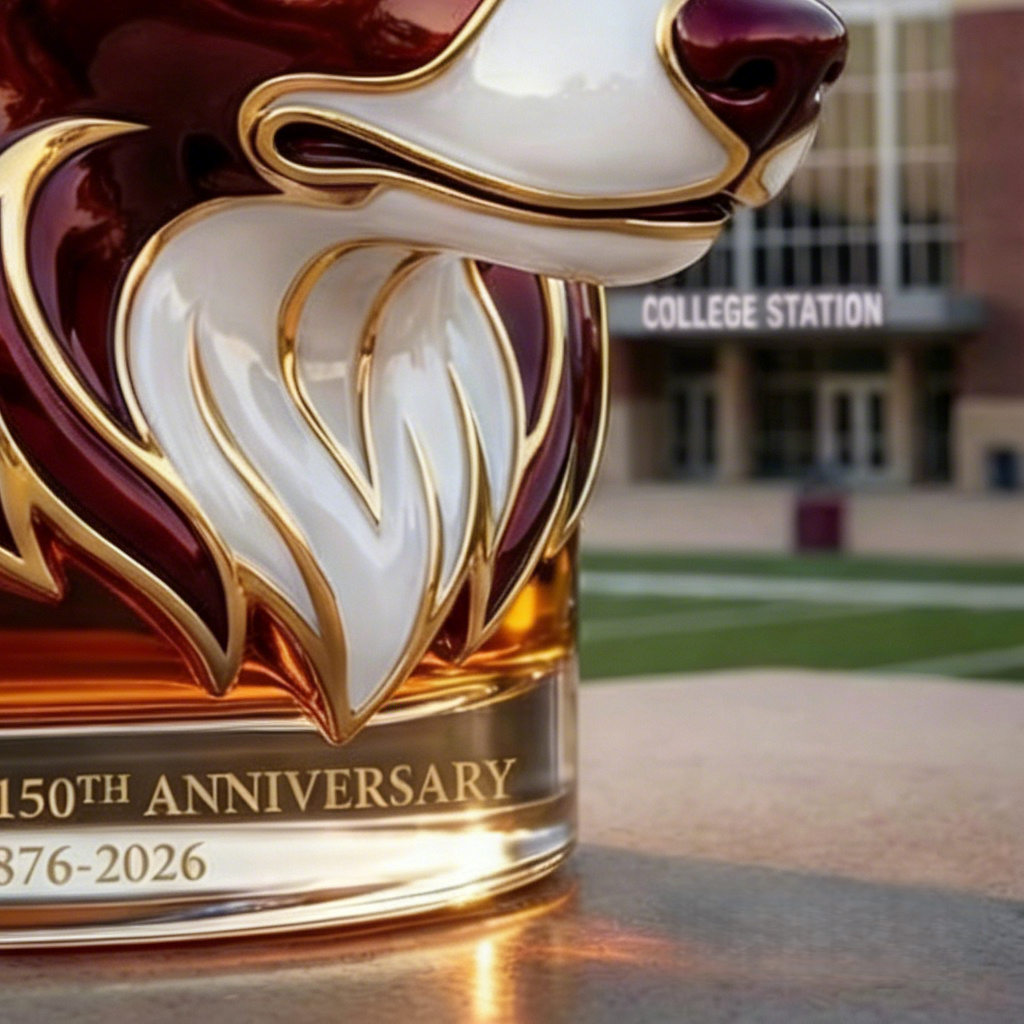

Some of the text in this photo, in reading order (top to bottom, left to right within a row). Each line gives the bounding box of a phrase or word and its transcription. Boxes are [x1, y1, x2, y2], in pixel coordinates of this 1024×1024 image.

[642, 292, 884, 329] COLLEGE STATION
[143, 758, 517, 817] ANNIVERSARY
